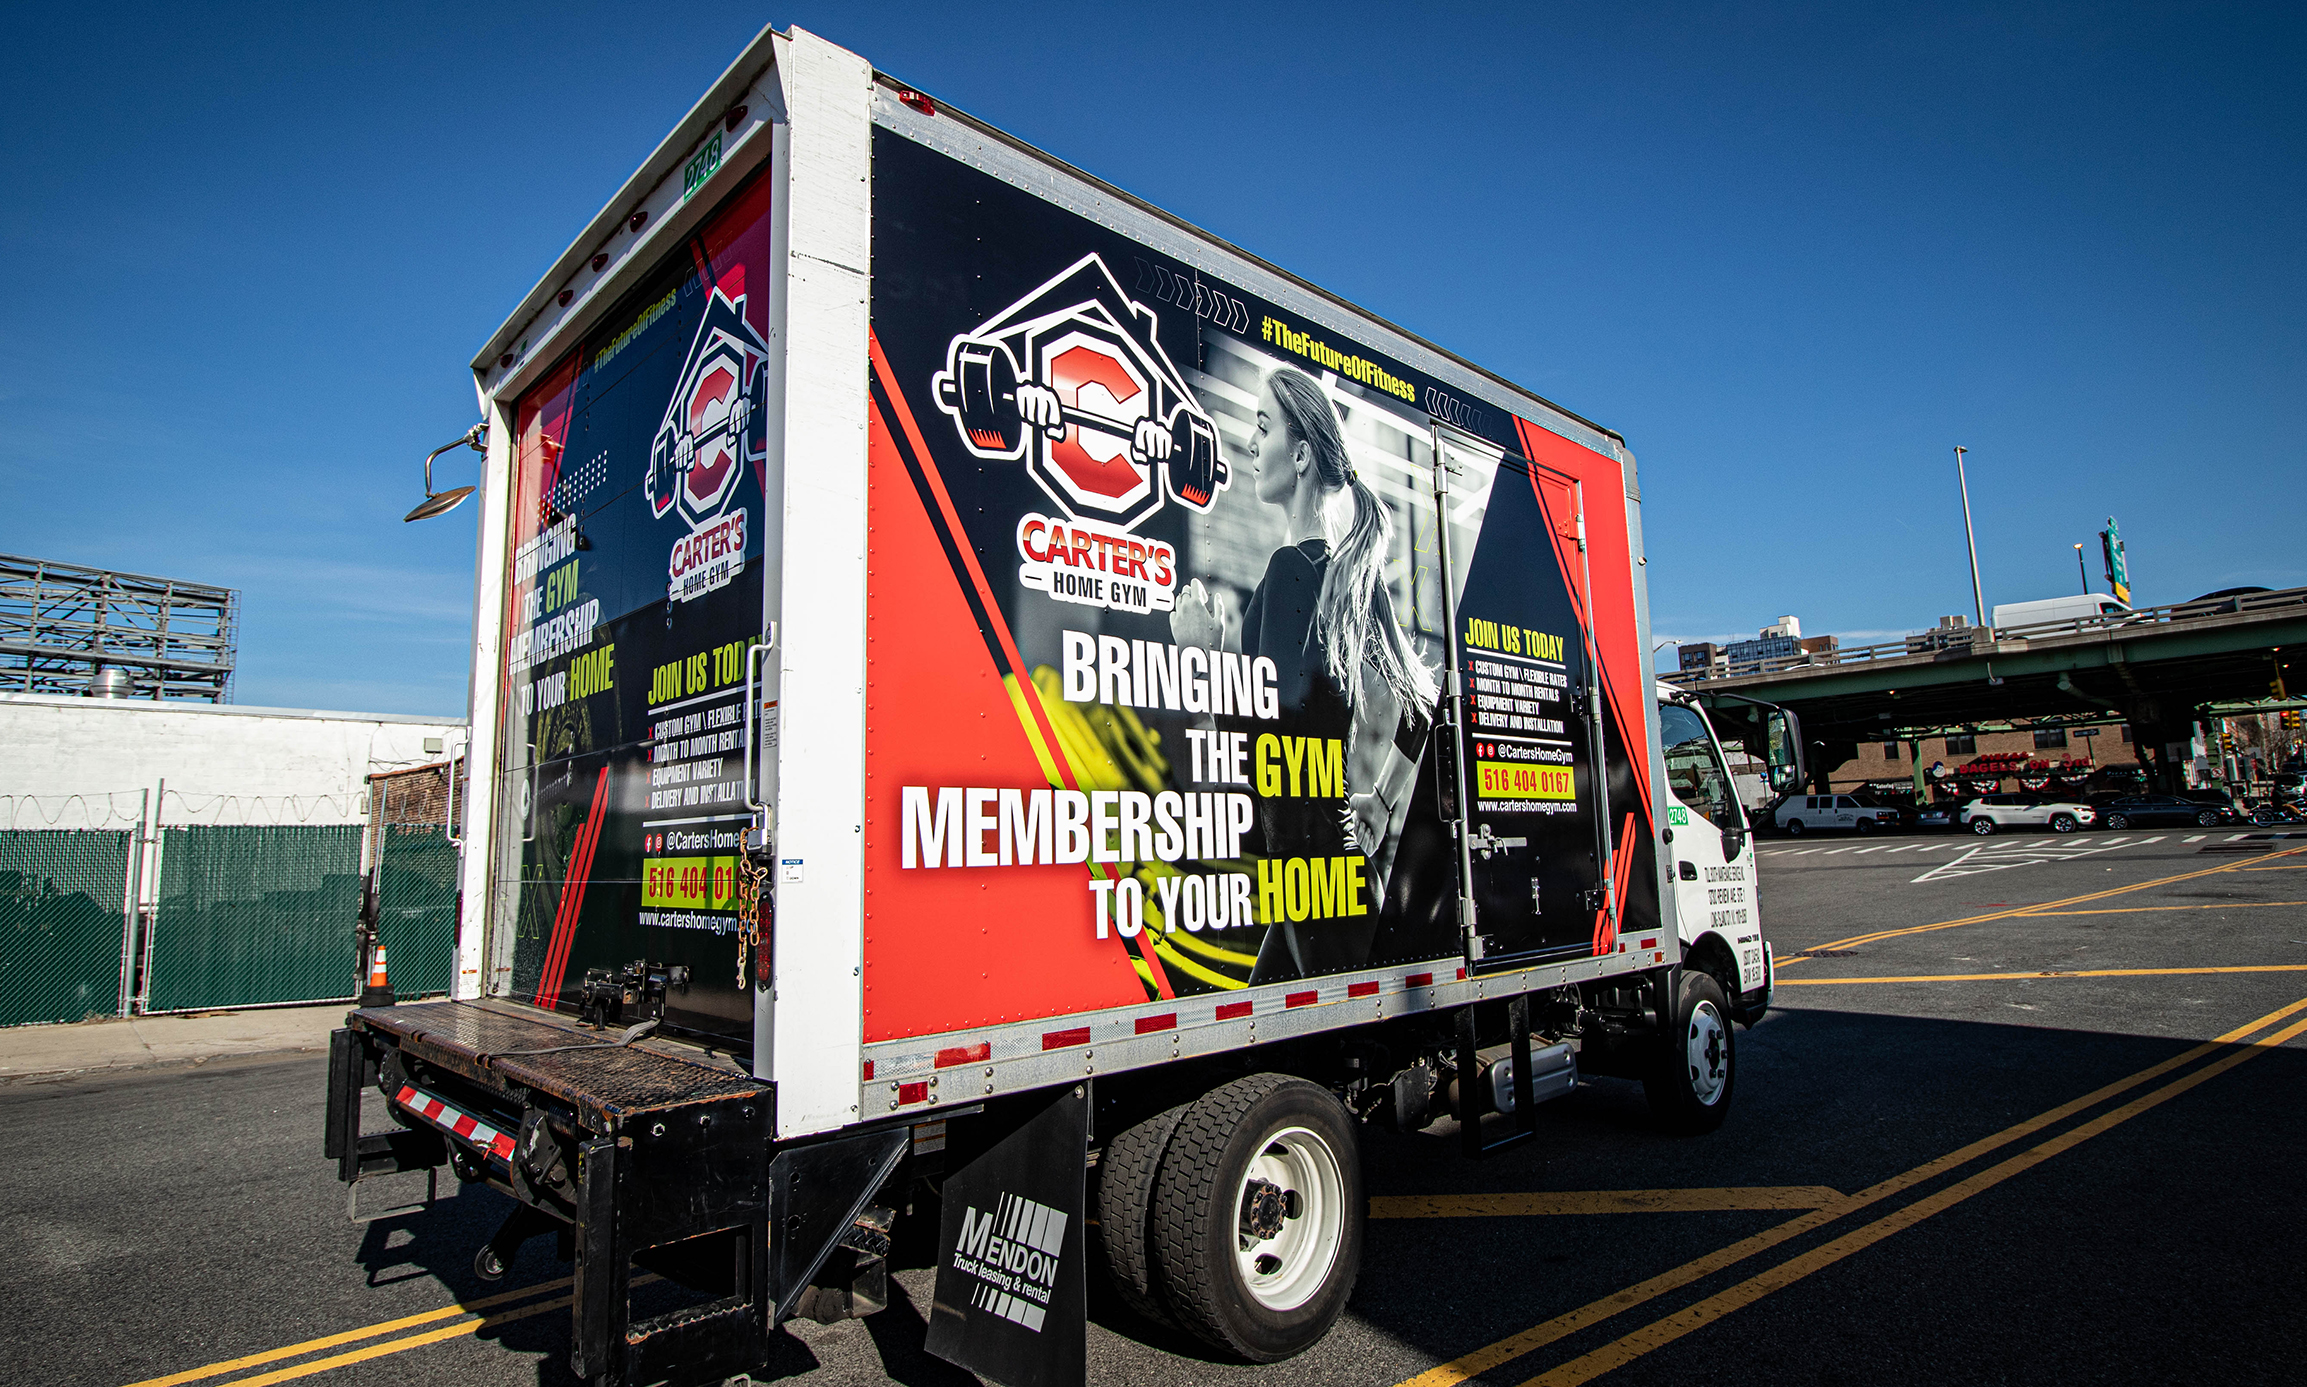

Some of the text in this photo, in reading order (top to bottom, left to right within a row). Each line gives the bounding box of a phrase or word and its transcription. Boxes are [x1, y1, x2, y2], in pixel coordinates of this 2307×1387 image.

[685, 138, 721, 195] 2748
[594, 288, 677, 373] #TheFutureOfFitness
[1262, 315, 1416, 403] #TheFutureOfFitness
[514, 513, 577, 586] BRINGING
[671, 513, 745, 578] CARTER'S
[1021, 519, 1173, 585] CARTER'S
[524, 559, 580, 624] THE GYM
[683, 560, 729, 597] HOME GYM
[1052, 571, 1148, 608] HOME GYM
[508, 599, 600, 676] MEMBERSHIP
[1465, 617, 1564, 662] JOIN US TODAY
[520, 643, 615, 718] TO YOUR HOME
[647, 660, 683, 705] JOIN
[686, 651, 708, 695] US
[1061, 629, 1280, 720] BRINGING
[1475, 660, 1503, 677] CUSTOM
[1504, 664, 1519, 680] GYM
[1523, 668, 1549, 685] FLEXIBLE
[1549, 672, 1567, 688] RATES
[1476, 677, 1560, 702] MONTH TO MONTH RENTALS
[655, 716, 684, 741] CUSTOM
[684, 711, 701, 735] GYM
[707, 702, 742, 730] FLEXIBLE
[1477, 694, 1539, 715] EQUIPMENT VARIETY
[1479, 711, 1564, 734] DELIVERY AND INSTALLATION
[654, 743, 679, 763] MONTH
[680, 740, 689, 759] TO
[690, 732, 718, 757] MONTH
[1185, 728, 1345, 799] THE GYM
[1498, 743, 1573, 765] @CartersHomeGym
[1958, 753, 2090, 774] BAGELS ON 3rd
[652, 757, 724, 788] EQUIPMENT VARIETY
[1484, 768, 1569, 793] 516 404 0167
[651, 779, 756, 810] DELIVERY AND INSTALLATIN
[1477, 799, 1577, 815] www.cartershomegym.com
[901, 786, 1255, 869] MEMBERSHIP
[1669, 808, 1687, 824] 2748
[666, 827, 748, 850] @CartersHome
[648, 867, 675, 898] 516
[680, 866, 707, 899] 404
[1089, 856, 1368, 939] TO YOUR HOME
[955, 1205, 1059, 1288] MENDON
[953, 1252, 1052, 1304] Truck leasing & rental
